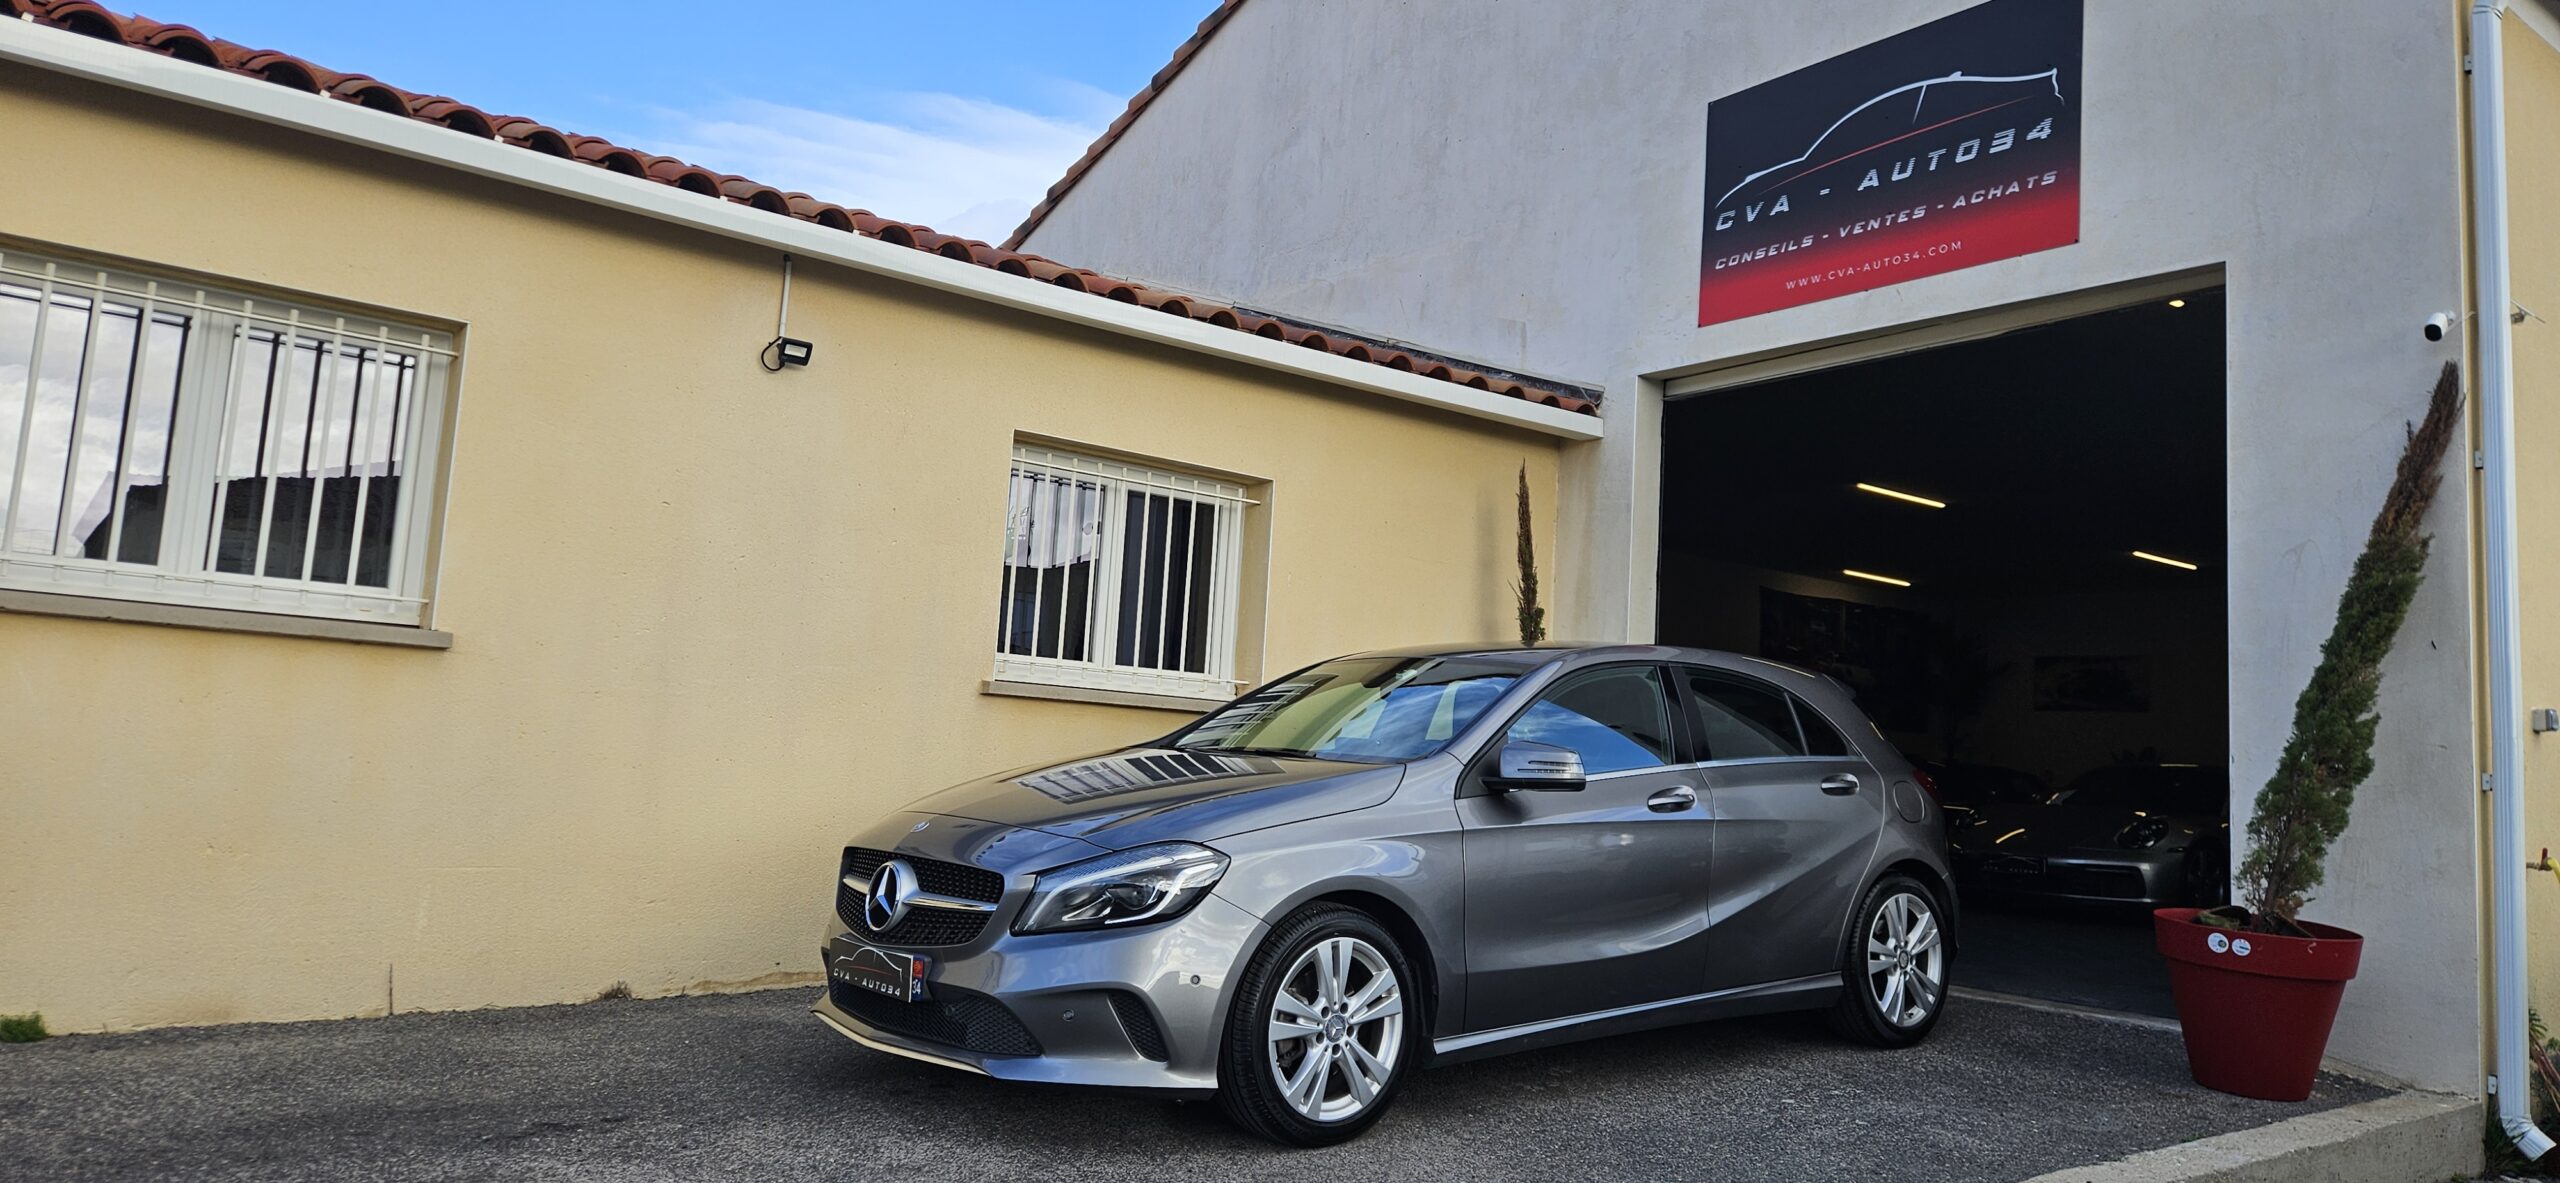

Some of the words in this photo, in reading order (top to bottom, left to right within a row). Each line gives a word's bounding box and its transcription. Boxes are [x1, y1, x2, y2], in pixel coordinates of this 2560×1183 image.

[1715, 194, 1790, 231] CVA
[1857, 117, 2054, 191] AUTO34
[1715, 235, 1814, 270] CONSEILS
[1839, 205, 1927, 238] VENTES
[1952, 170, 2058, 209] ACHATS
[1786, 241, 1962, 289] WWW.CVA-AUTO34.COM
[833, 968, 850, 980] CVA
[861, 978, 901, 996] AUTO34
[912, 980, 921, 995] 34
